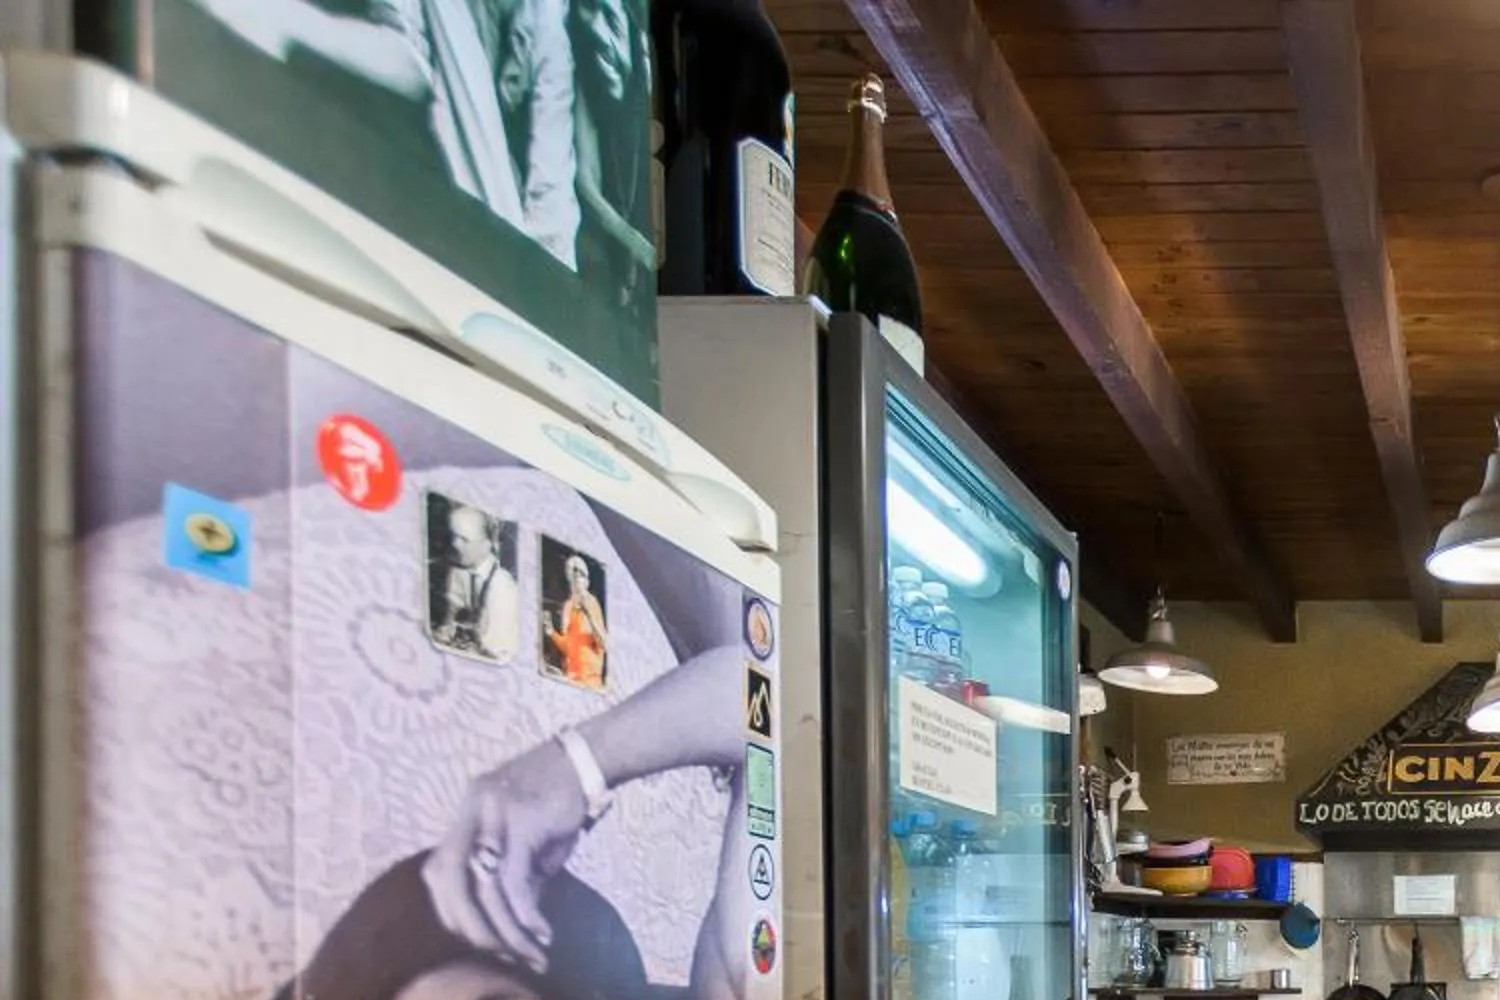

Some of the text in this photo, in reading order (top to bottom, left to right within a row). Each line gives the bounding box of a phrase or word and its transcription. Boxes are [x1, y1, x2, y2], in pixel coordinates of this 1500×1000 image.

[1300, 803, 1330, 824] LO
[1331, 801, 1359, 823] DE
[1361, 799, 1420, 821] TODOS
